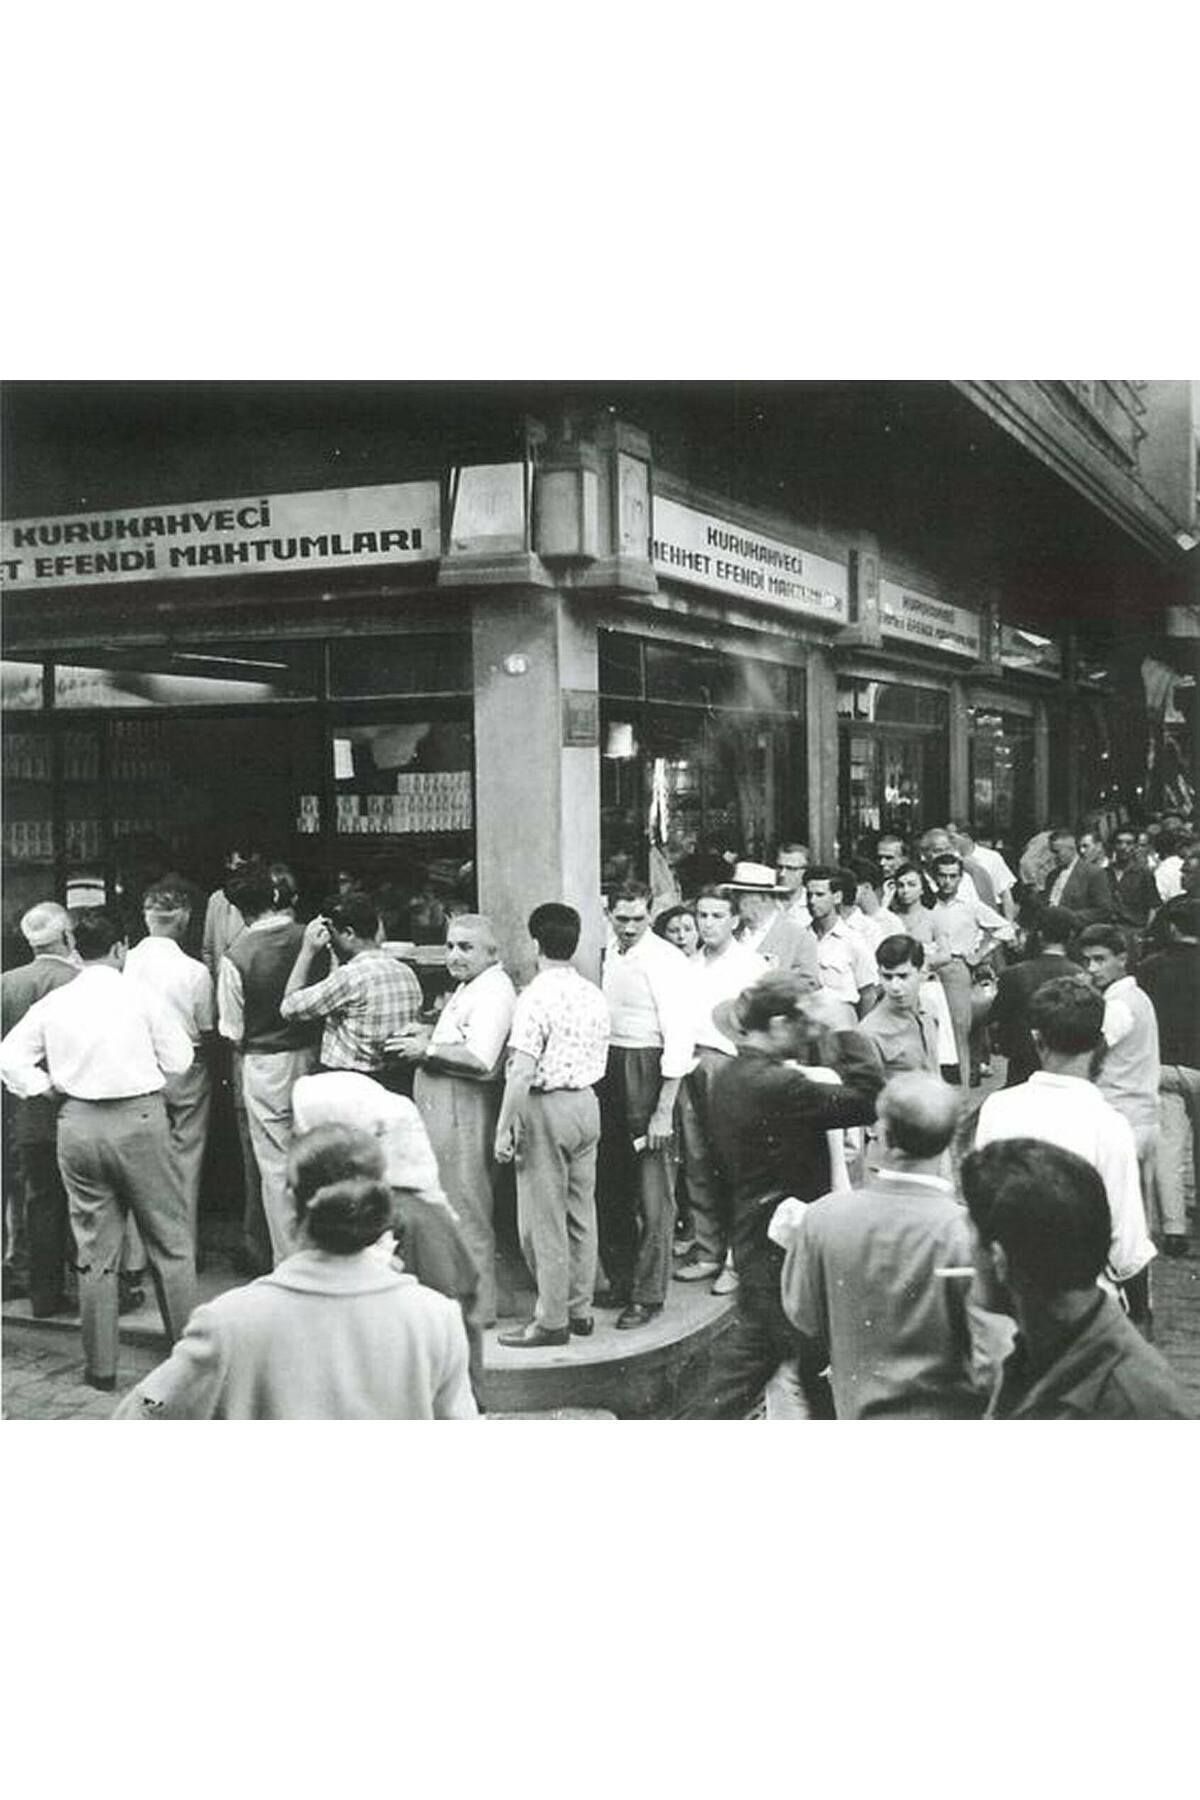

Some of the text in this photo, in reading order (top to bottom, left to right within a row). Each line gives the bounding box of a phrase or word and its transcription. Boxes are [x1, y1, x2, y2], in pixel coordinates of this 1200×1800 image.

[13, 499, 271, 548] KURUKAHVECİ
[35, 543, 156, 578] EFENDİ
[169, 528, 422, 567] MAHTUMLARI
[706, 526, 802, 575] KURUKAHVECİ
[716, 559, 765, 590] EFENDİ
